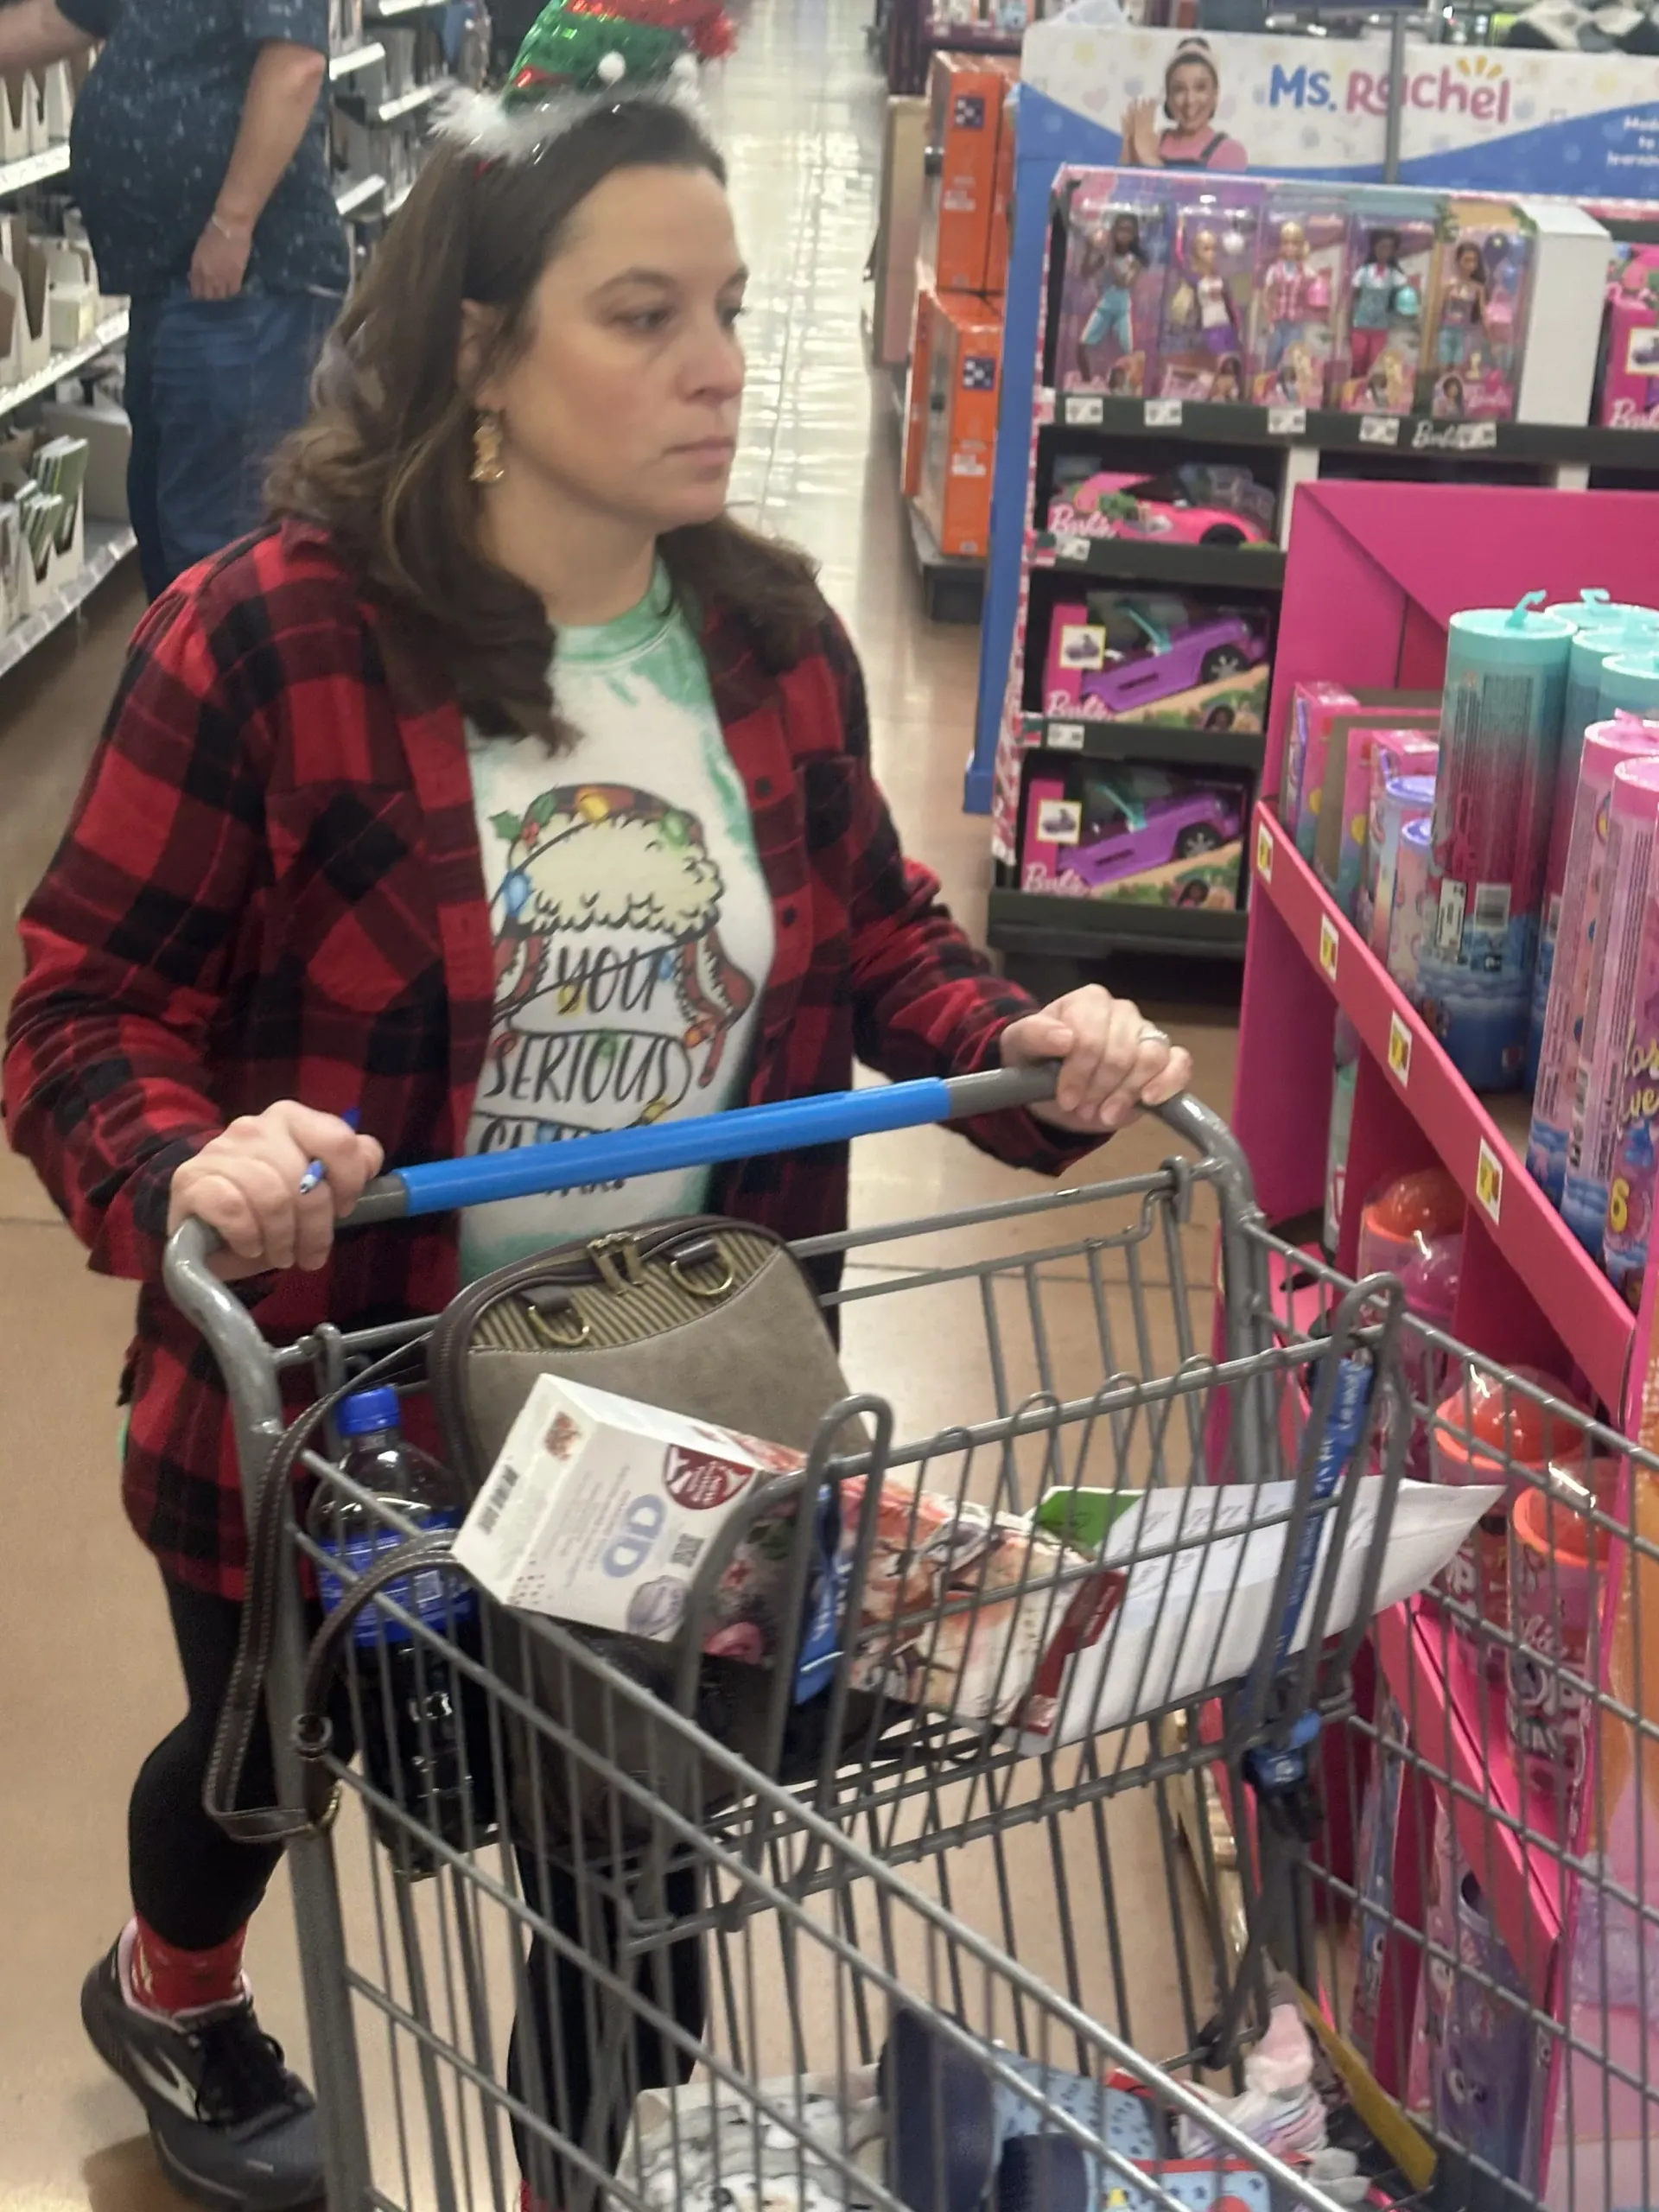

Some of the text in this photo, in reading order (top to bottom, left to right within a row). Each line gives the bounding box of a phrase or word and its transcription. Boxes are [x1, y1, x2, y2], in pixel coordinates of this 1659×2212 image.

[1268, 63, 1511, 124] Ms. Rachel
[482, 1033, 677, 1104] SERIOUS
